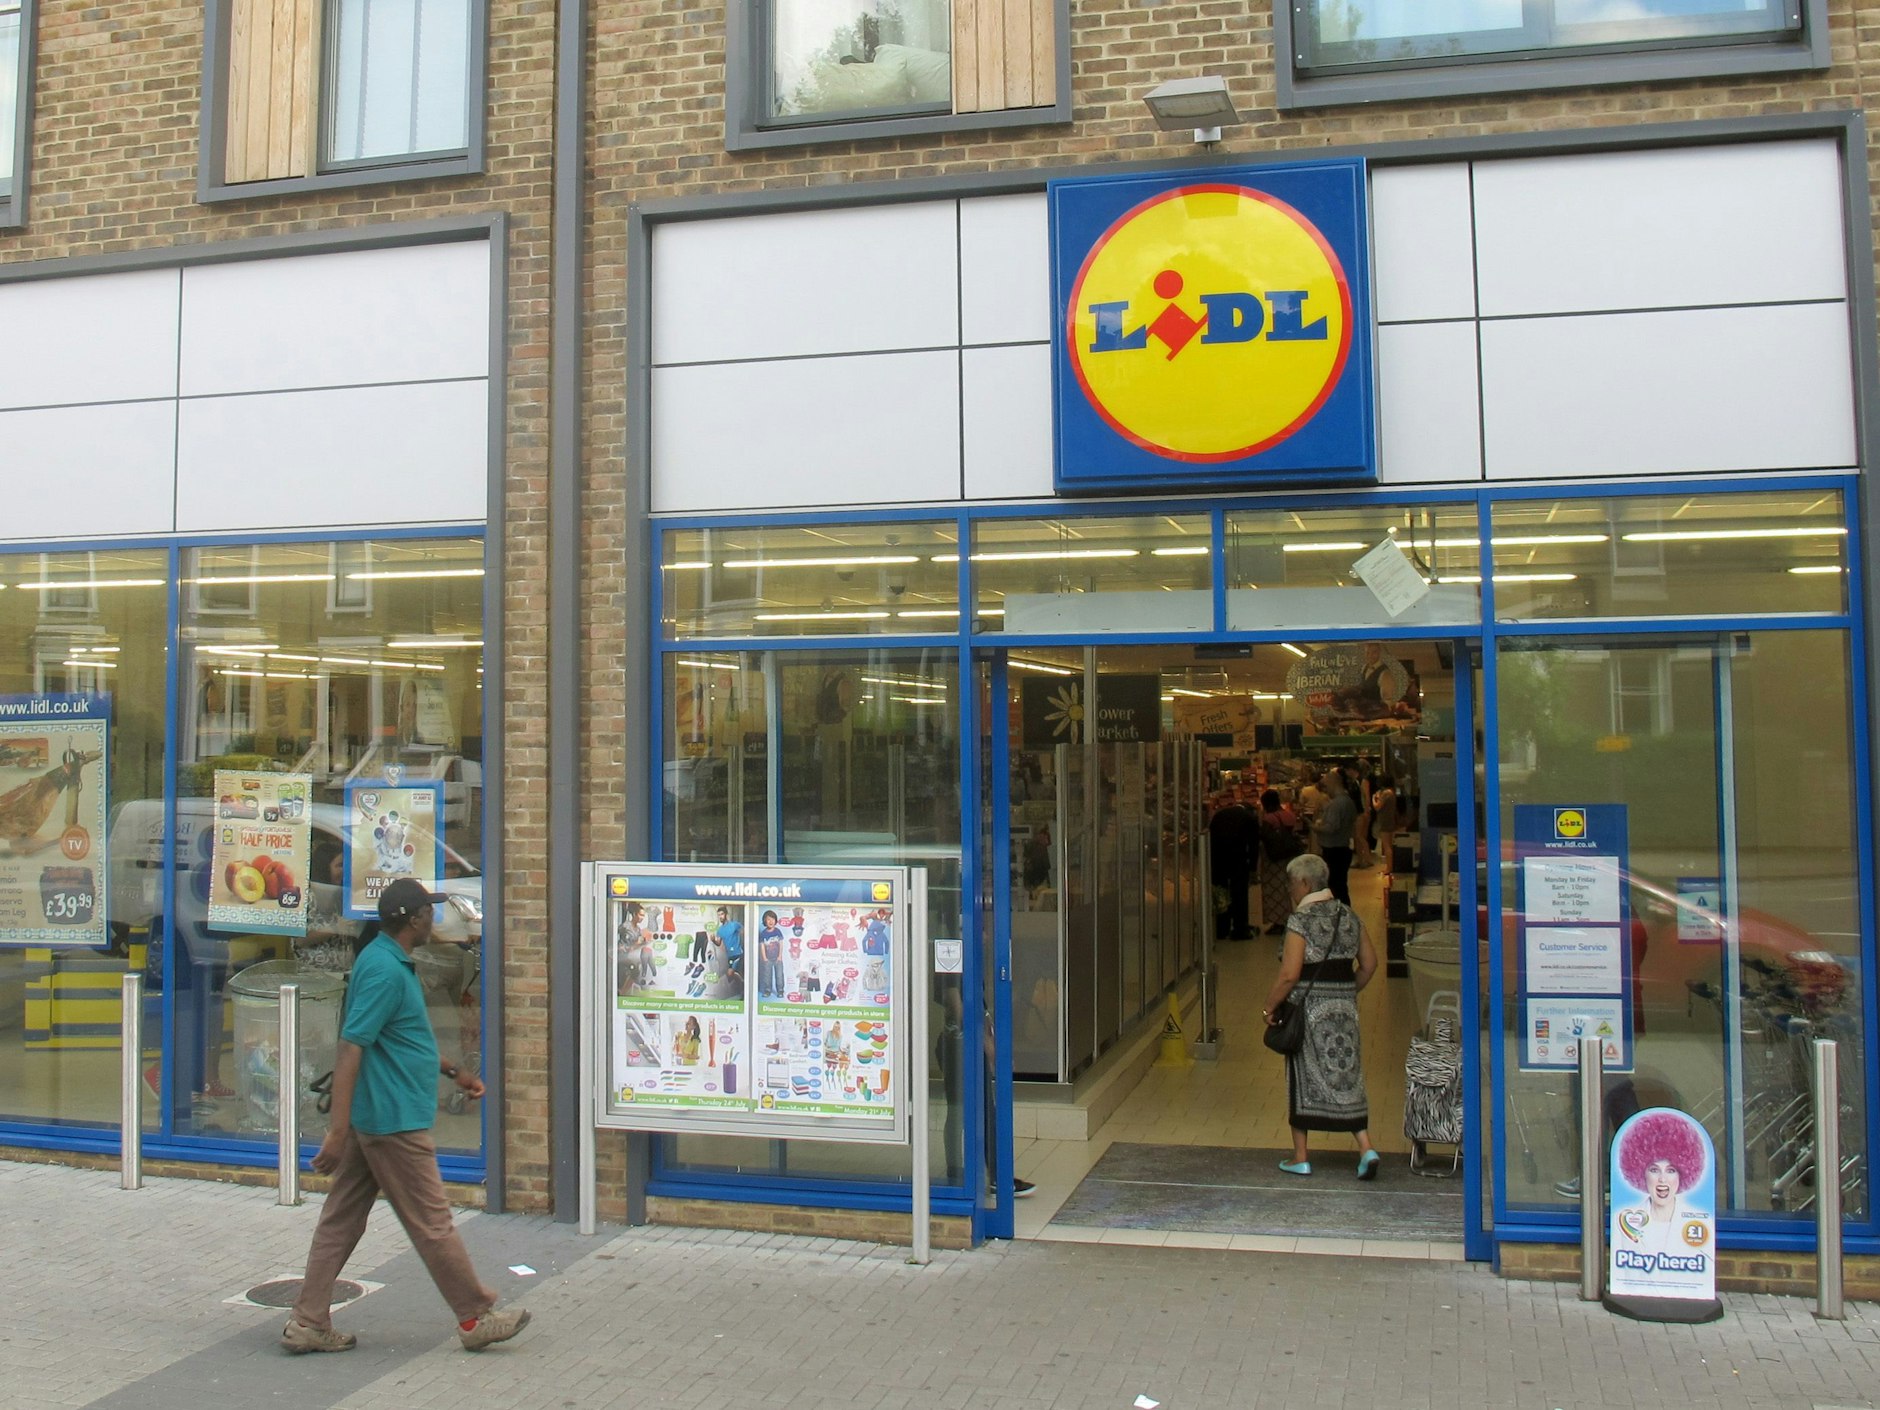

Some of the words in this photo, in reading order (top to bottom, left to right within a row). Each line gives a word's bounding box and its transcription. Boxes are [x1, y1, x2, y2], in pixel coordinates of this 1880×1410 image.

[1098, 708, 1135, 721] ower
[1200, 709, 1228, 725] Fresh
[1098, 724, 1139, 740] arket
[68, 840, 82, 850] TV
[240, 832, 263, 847] HALF
[265, 833, 293, 848] PRICE
[366, 877, 381, 887] WE
[695, 882, 801, 898] www.lidl.co.uk
[46, 893, 93, 918] £39.99
[12, 908, 26, 919] Leg
[1539, 943, 1576, 951] Customer
[1578, 942, 1608, 951] Service
[694, 1002, 718, 1010] products
[1535, 1006, 1565, 1015] Further
[1568, 1007, 1615, 1016] Information
[837, 1008, 862, 1016] products
[698, 1097, 721, 1107] Thursday
[844, 1107, 868, 1115] Monday
[1687, 1225, 1703, 1239] £1
[1616, 1250, 1656, 1273] Play
[1657, 1252, 1705, 1272] here!
